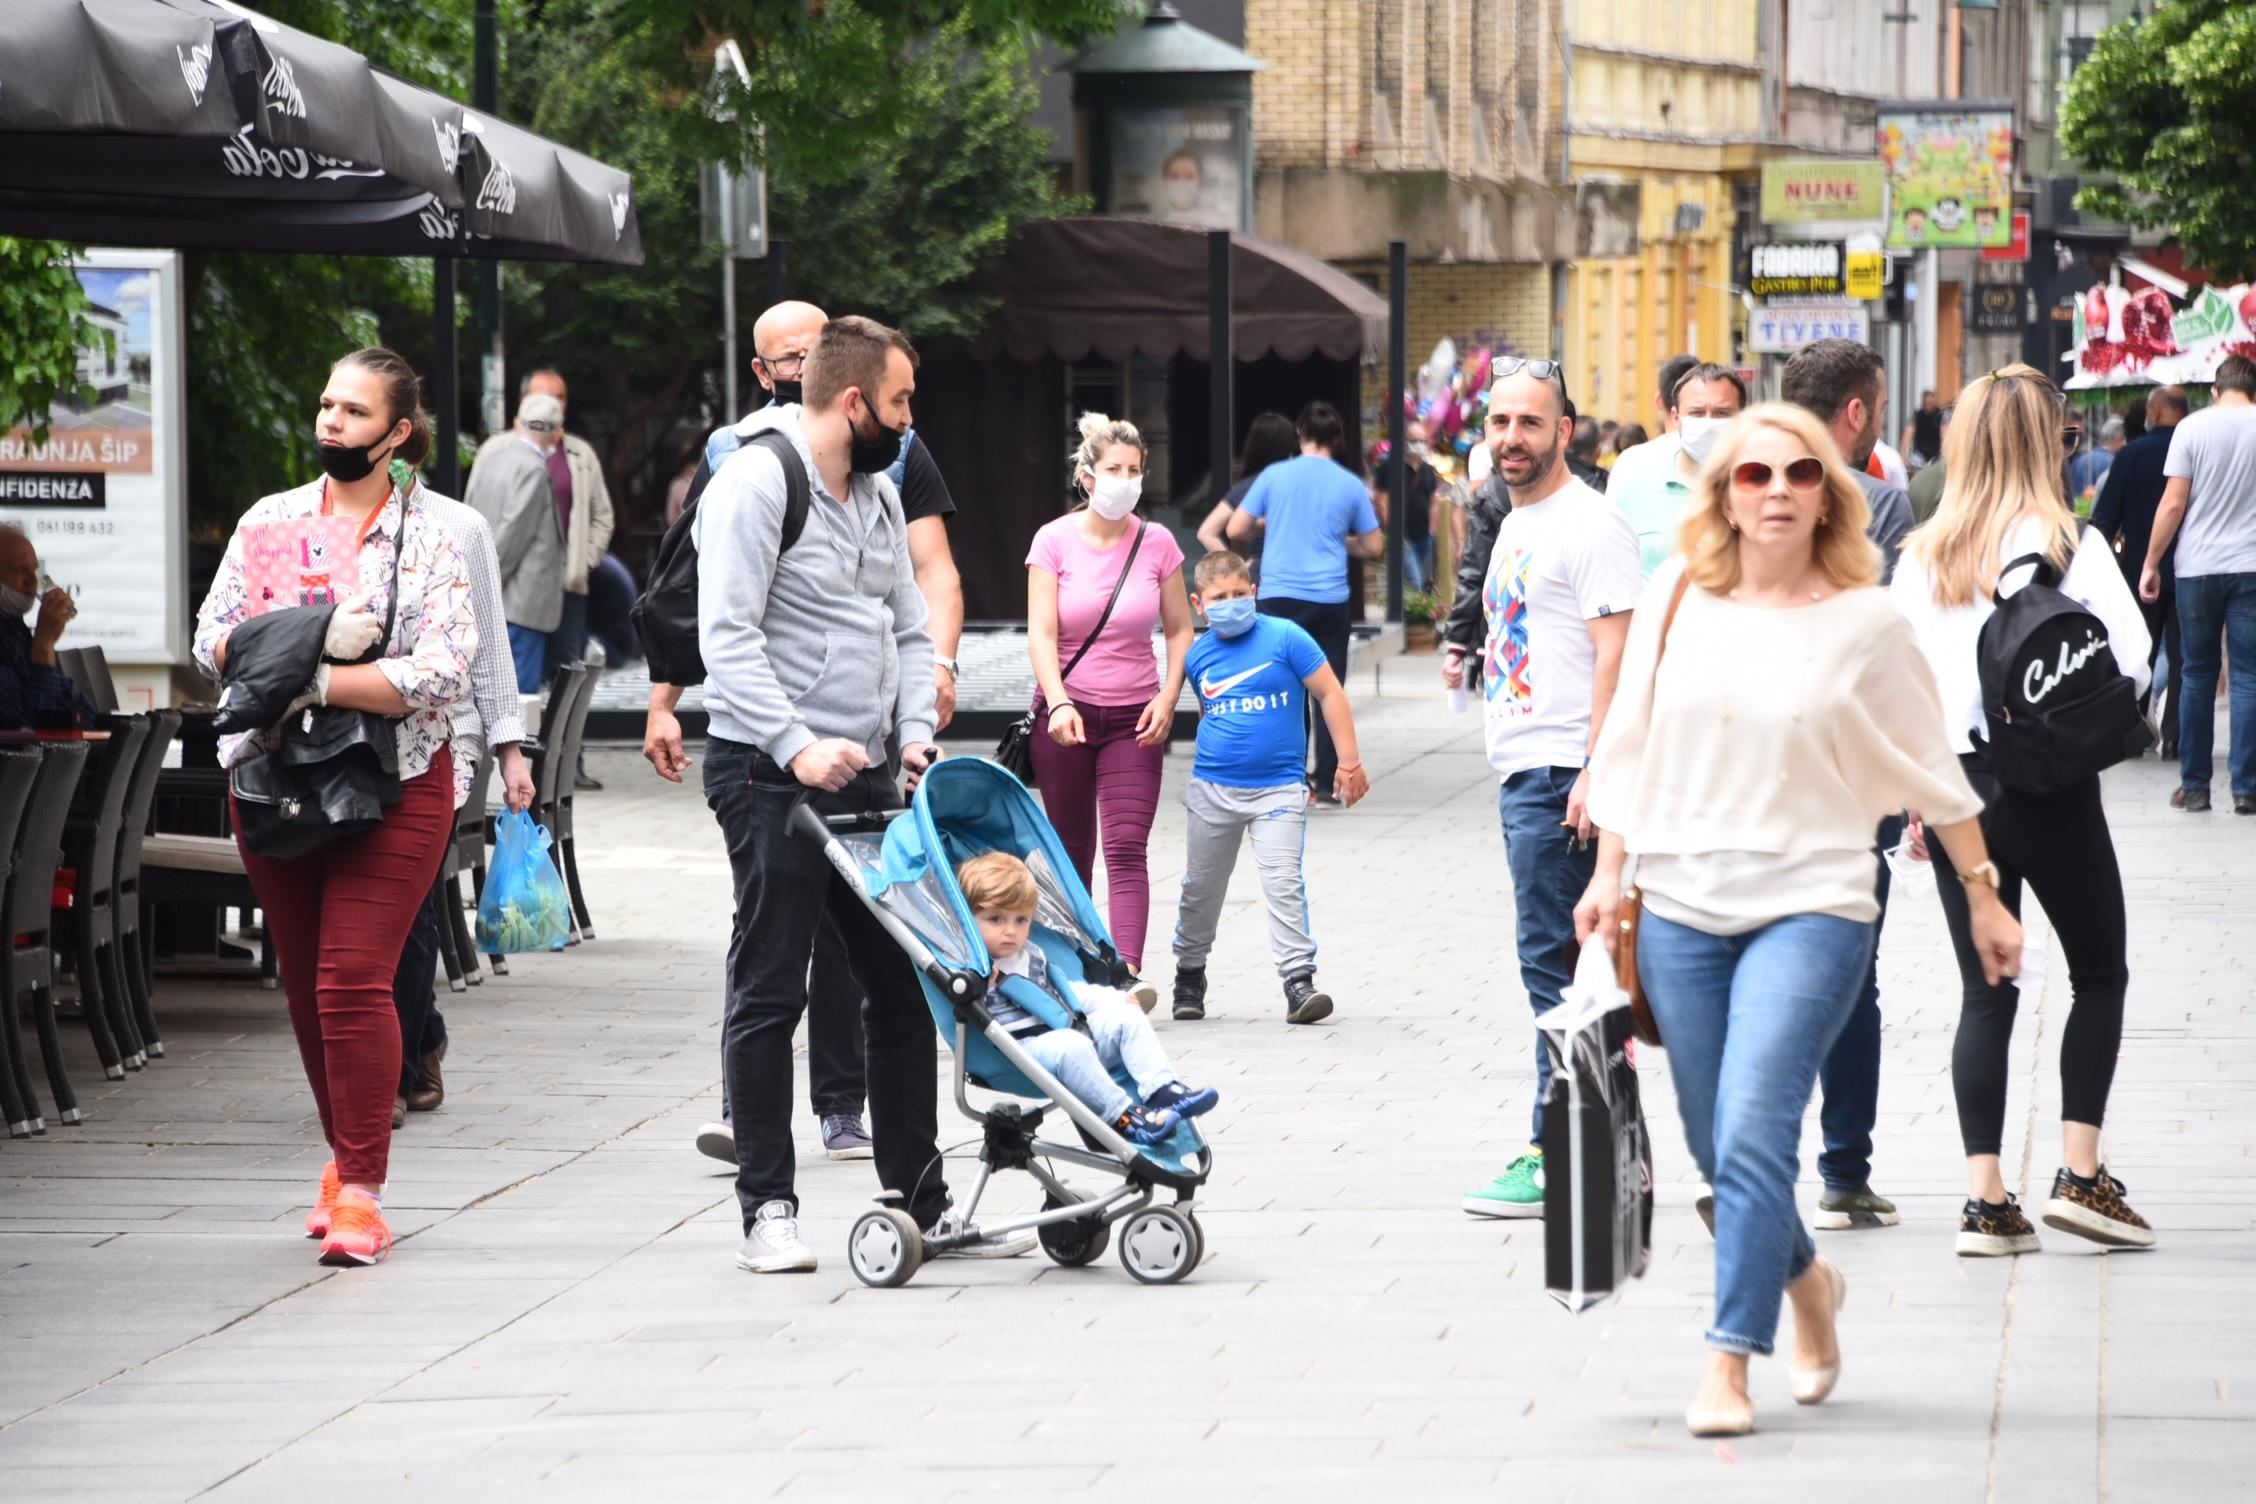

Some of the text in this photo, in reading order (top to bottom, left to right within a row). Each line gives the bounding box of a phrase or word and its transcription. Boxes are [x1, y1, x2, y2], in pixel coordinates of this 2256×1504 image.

[1784, 182, 1860, 200] NUNE
[1762, 323, 1859, 341] TIVENE
[100, 434, 139, 463] ŠIP
[1241, 695, 1266, 712] DO
[1270, 691, 1288, 709] IT
